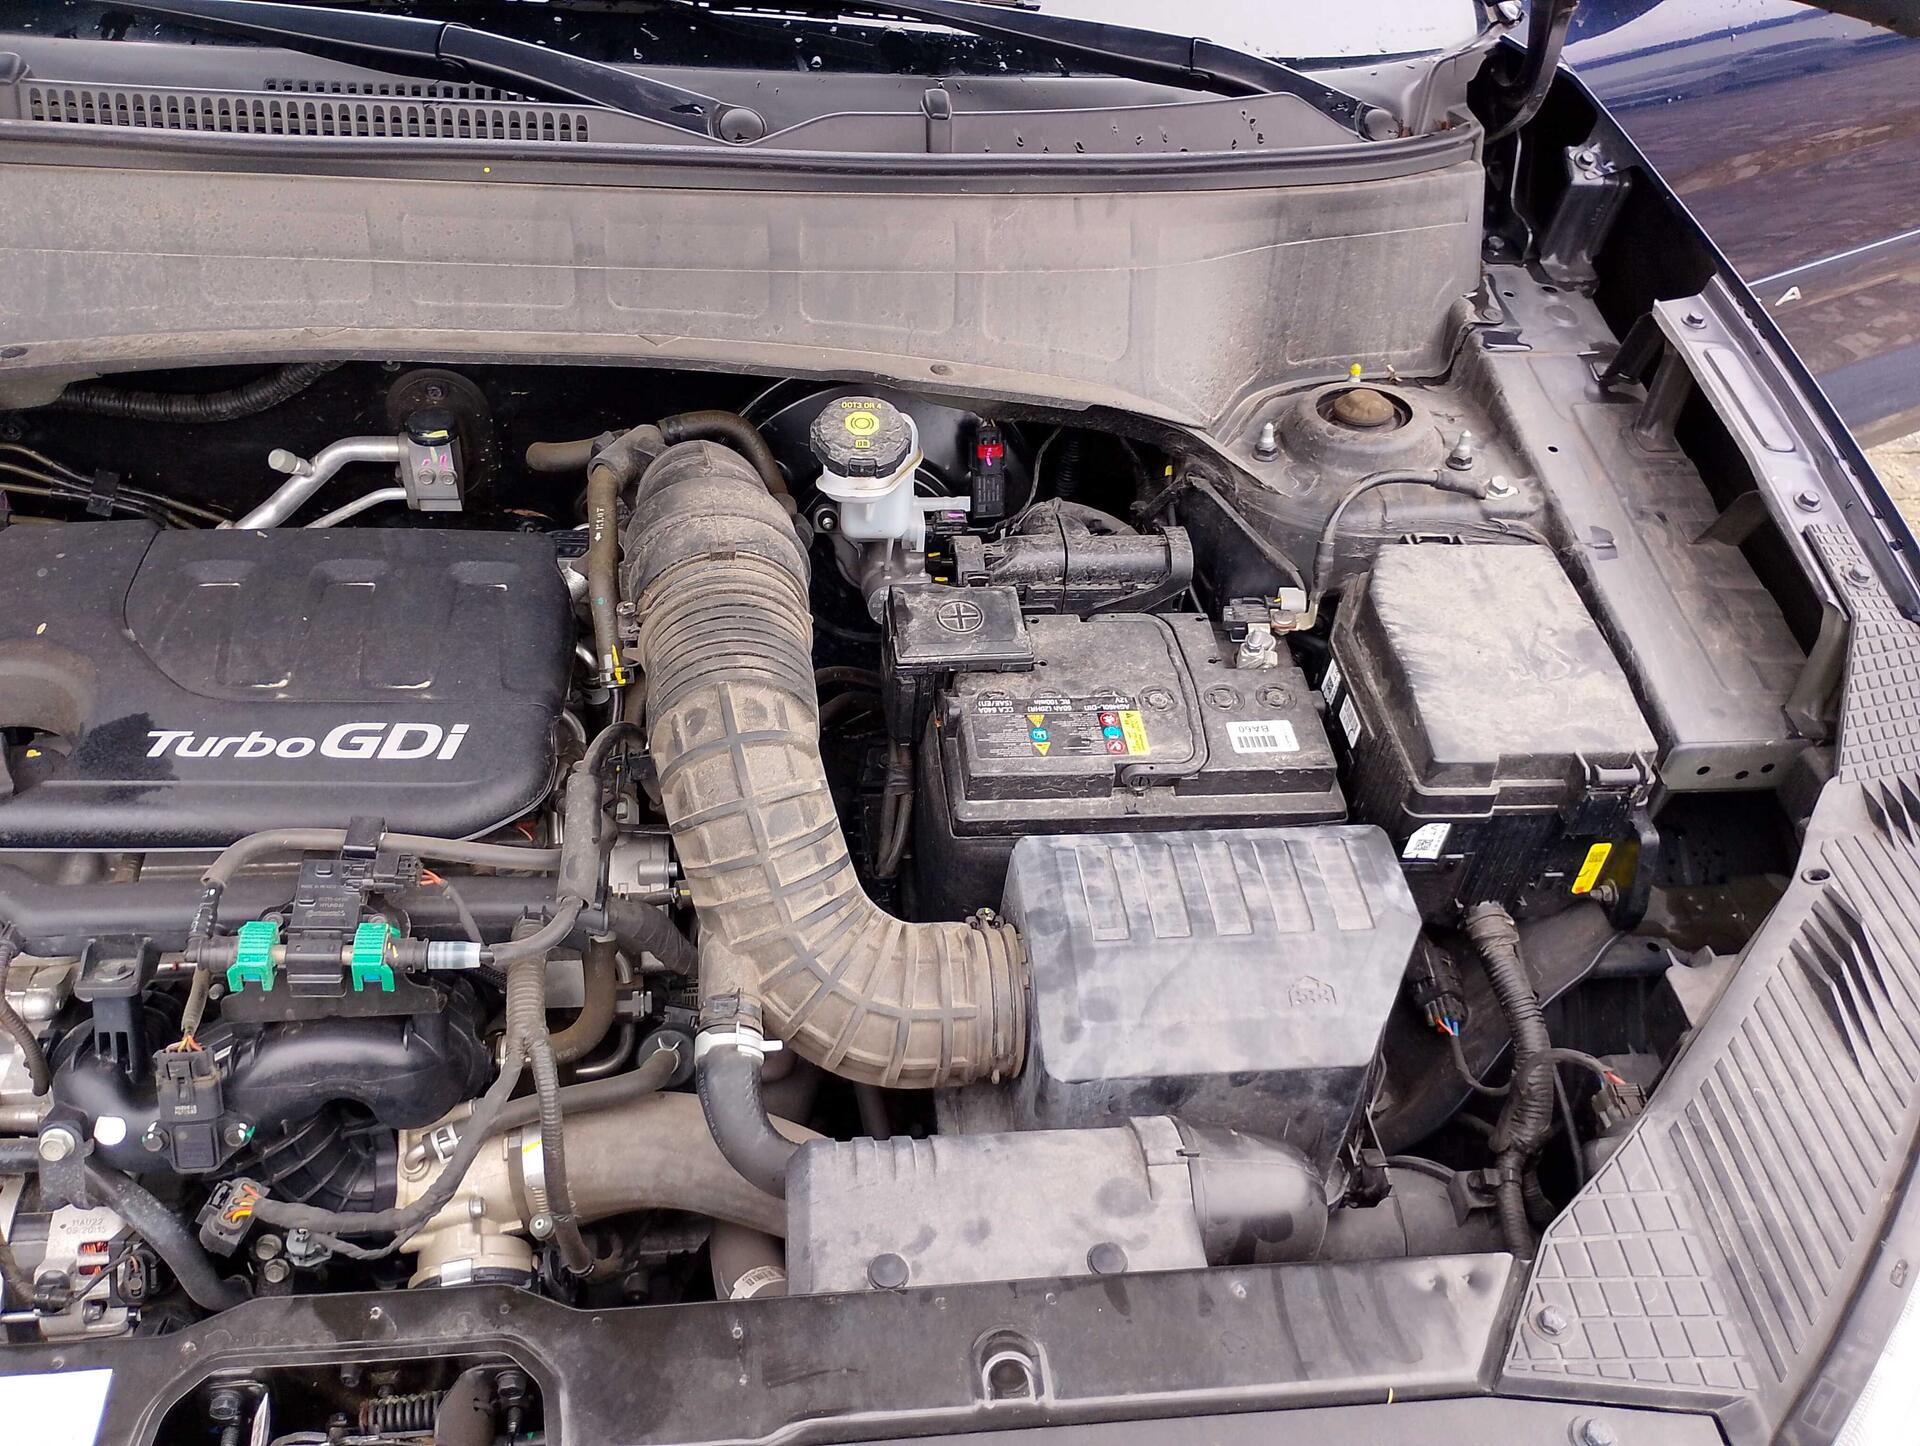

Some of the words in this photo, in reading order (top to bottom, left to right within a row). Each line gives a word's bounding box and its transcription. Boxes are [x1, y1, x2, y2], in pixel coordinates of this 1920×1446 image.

[841, 401, 861, 409] DOT3
[863, 401, 875, 409] OR
[997, 705, 1014, 713] CCA
